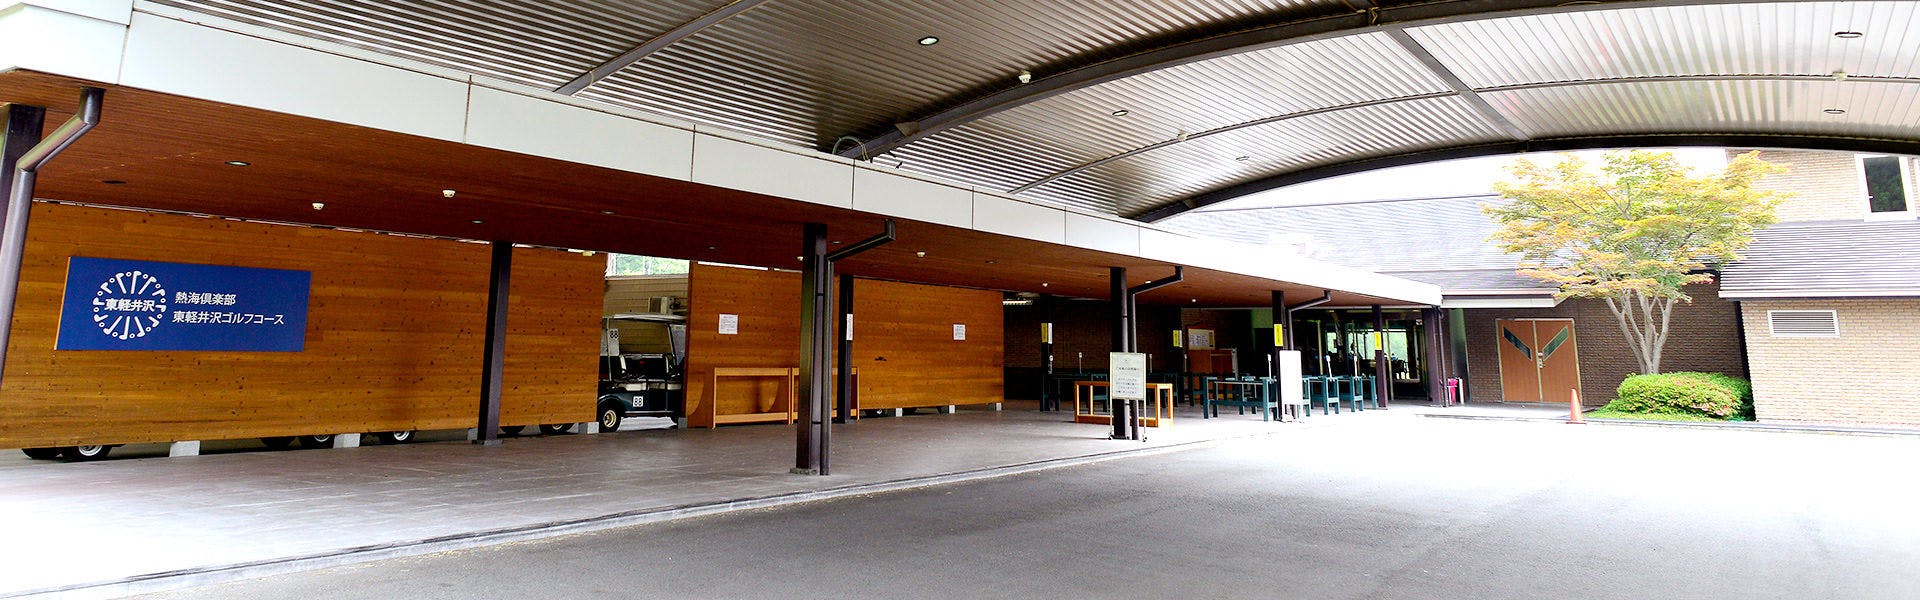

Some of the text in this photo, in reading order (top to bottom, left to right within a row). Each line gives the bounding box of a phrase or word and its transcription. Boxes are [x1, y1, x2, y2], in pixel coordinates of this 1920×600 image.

[104, 298, 155, 312] 東軽井沢
[172, 311, 285, 325] 東軽井沢ゴルフコース
[609, 330, 619, 339] 88
[633, 397, 643, 406] 88
